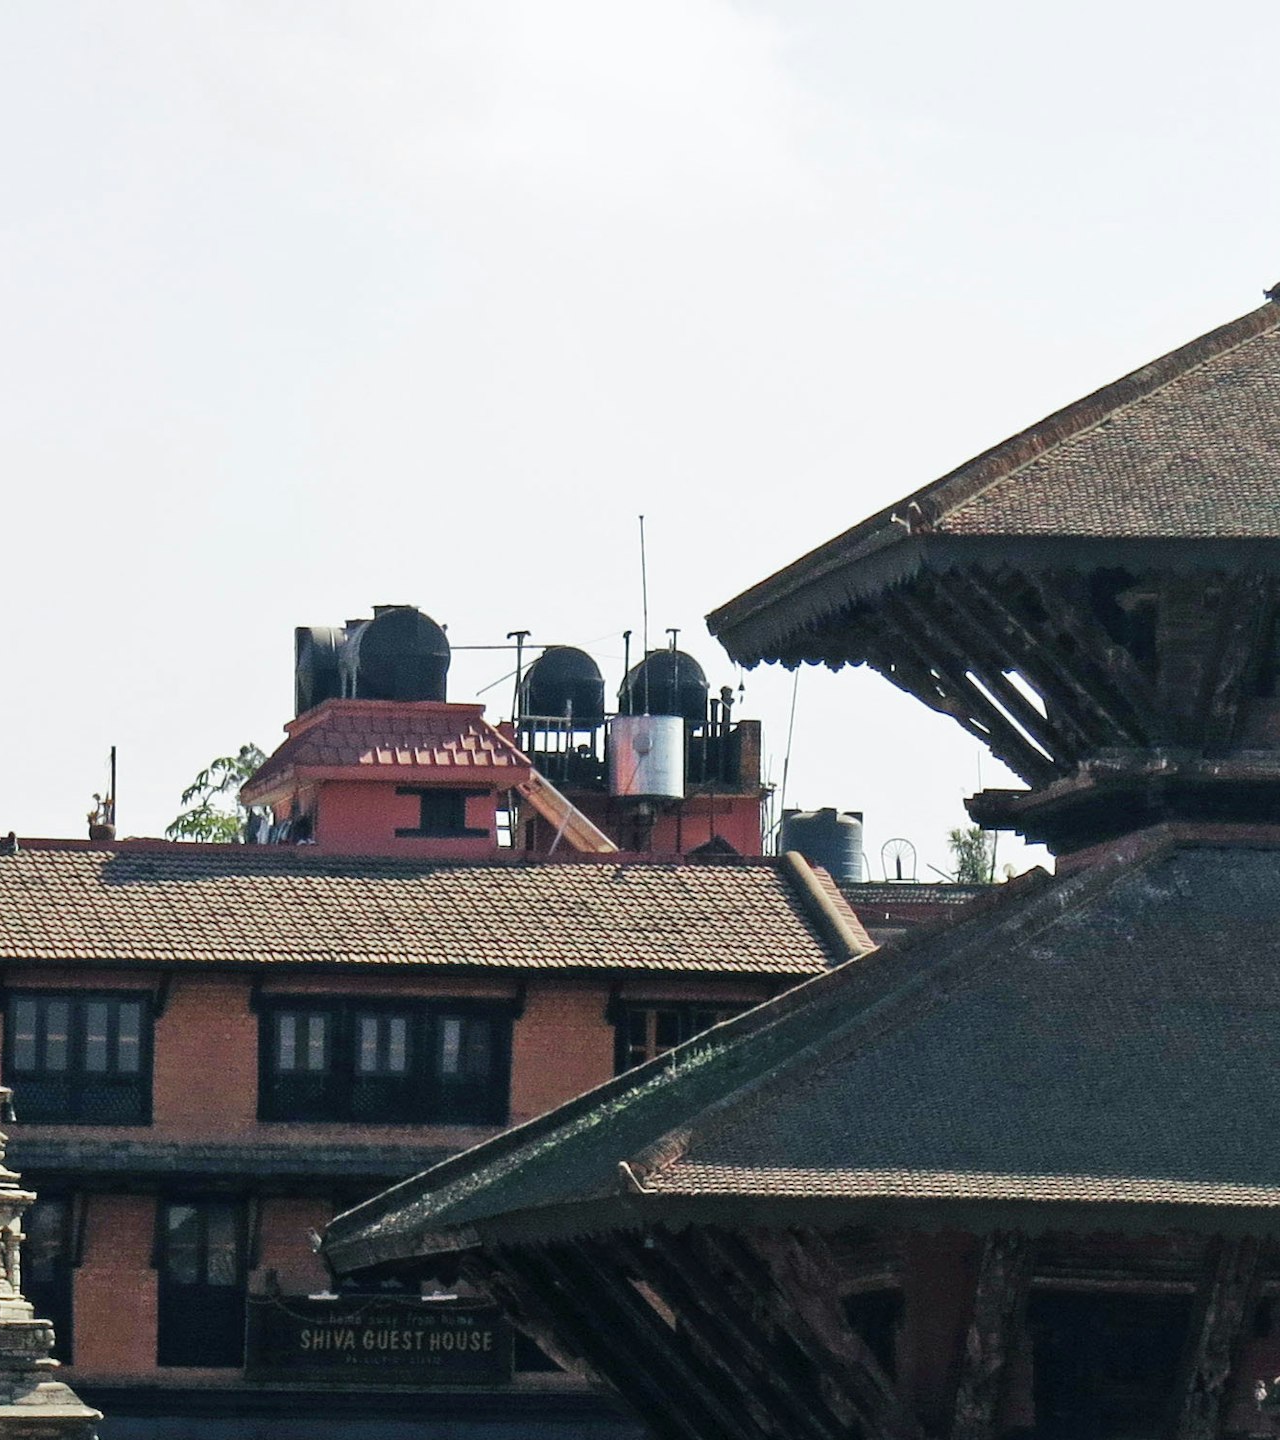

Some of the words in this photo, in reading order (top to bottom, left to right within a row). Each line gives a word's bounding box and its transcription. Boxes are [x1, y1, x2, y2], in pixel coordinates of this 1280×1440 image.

[300, 1329, 356, 1351] SHIVA
[362, 1329, 425, 1351] GUEST
[429, 1331, 493, 1352] HOUSE
